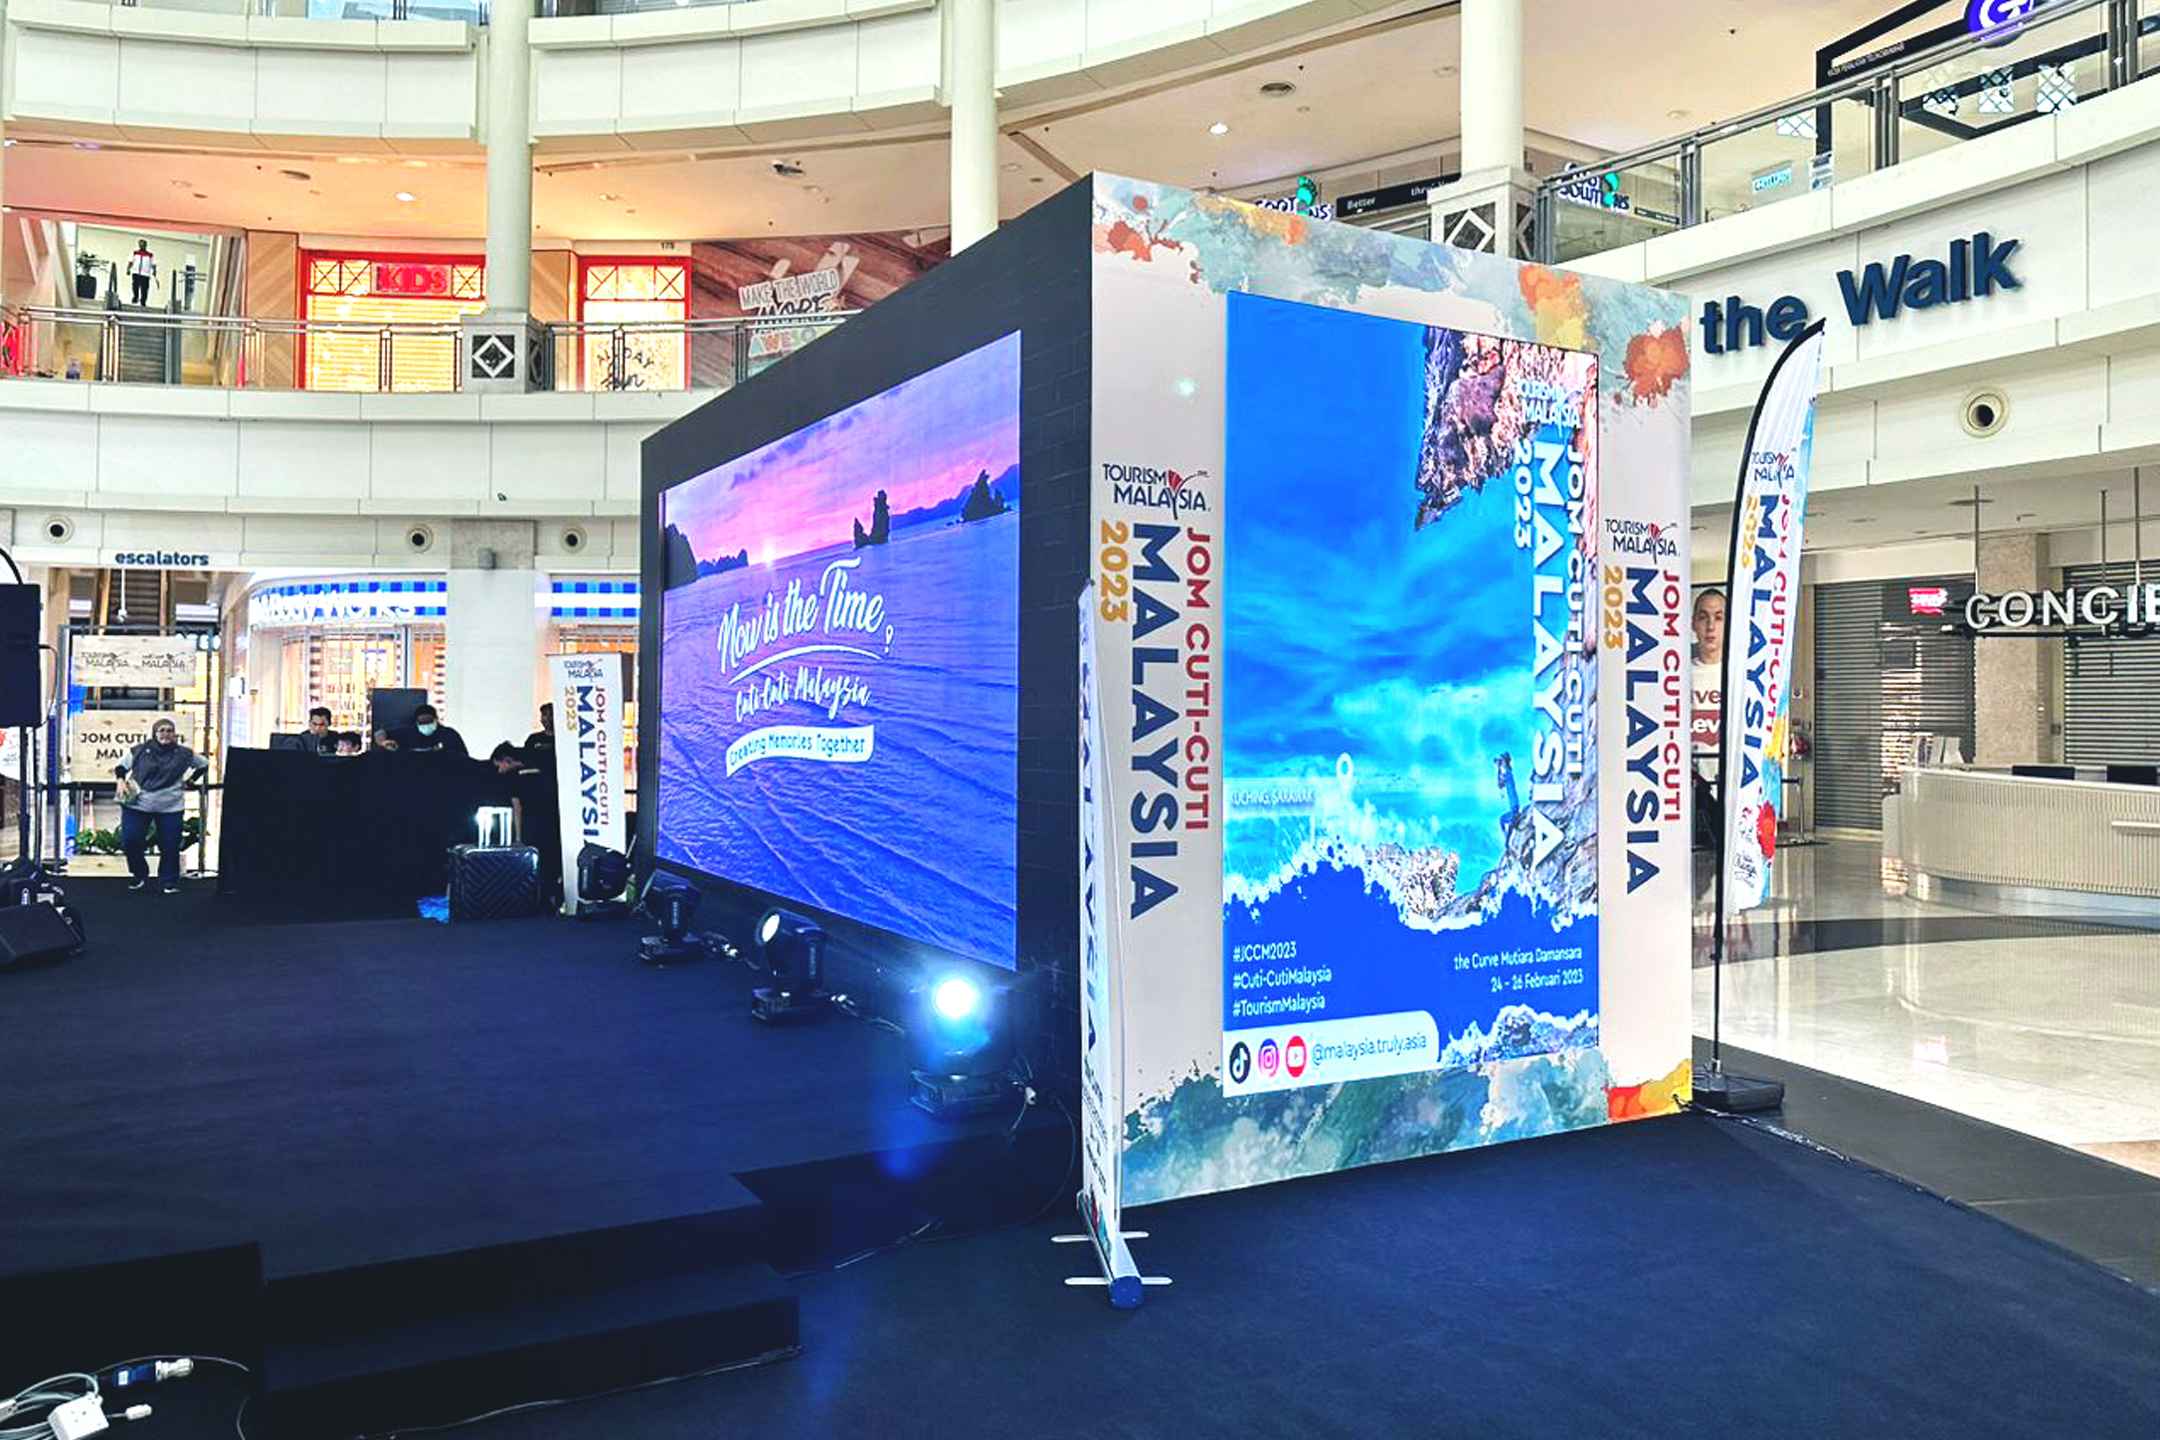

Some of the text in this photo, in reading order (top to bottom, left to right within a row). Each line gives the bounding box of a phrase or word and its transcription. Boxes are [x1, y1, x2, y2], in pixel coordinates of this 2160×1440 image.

[376, 262, 448, 293] KIDS
[1699, 231, 2024, 355] the Walk
[1102, 463, 1168, 486] TOURISM
[1113, 484, 1207, 520] MALAYSIA
[1514, 437, 1533, 549] 2023
[114, 550, 209, 566] escalators
[1605, 519, 1652, 535] TOURISM
[1613, 533, 1678, 564] MALAYSIA
[1101, 518, 1129, 622] 2023
[1566, 444, 1584, 777] JOM CUTI-CUTI
[1604, 565, 1624, 650] 2023
[717, 602, 762, 674] Now
[763, 592, 780, 644] is
[783, 578, 820, 637] the
[1533, 440, 1566, 870] MALAYSIA
[1740, 494, 1780, 789] MALAYSIA
[564, 685, 577, 731] 2023
[794, 666, 872, 720] Malaysia
[1185, 527, 1211, 830] JOM CUTI-CUTI
[1663, 570, 1681, 821] JOM CUTI-CUTI
[81, 733, 111, 743] JOM
[576, 685, 600, 842] MALAYSI
[596, 686, 609, 826] JOM CUTI-CUTI
[768, 733, 813, 751] Memories
[816, 733, 865, 758] Together
[1131, 523, 1181, 920] MALAYSIA
[1626, 567, 1660, 894] MALAYSIA
[1453, 947, 1582, 970] the Curve Mutiara Damansara
[1524, 969, 1561, 989] Februari
[1562, 967, 1584, 986] 2023
[1232, 991, 1326, 1017] #TourismMalaysia
